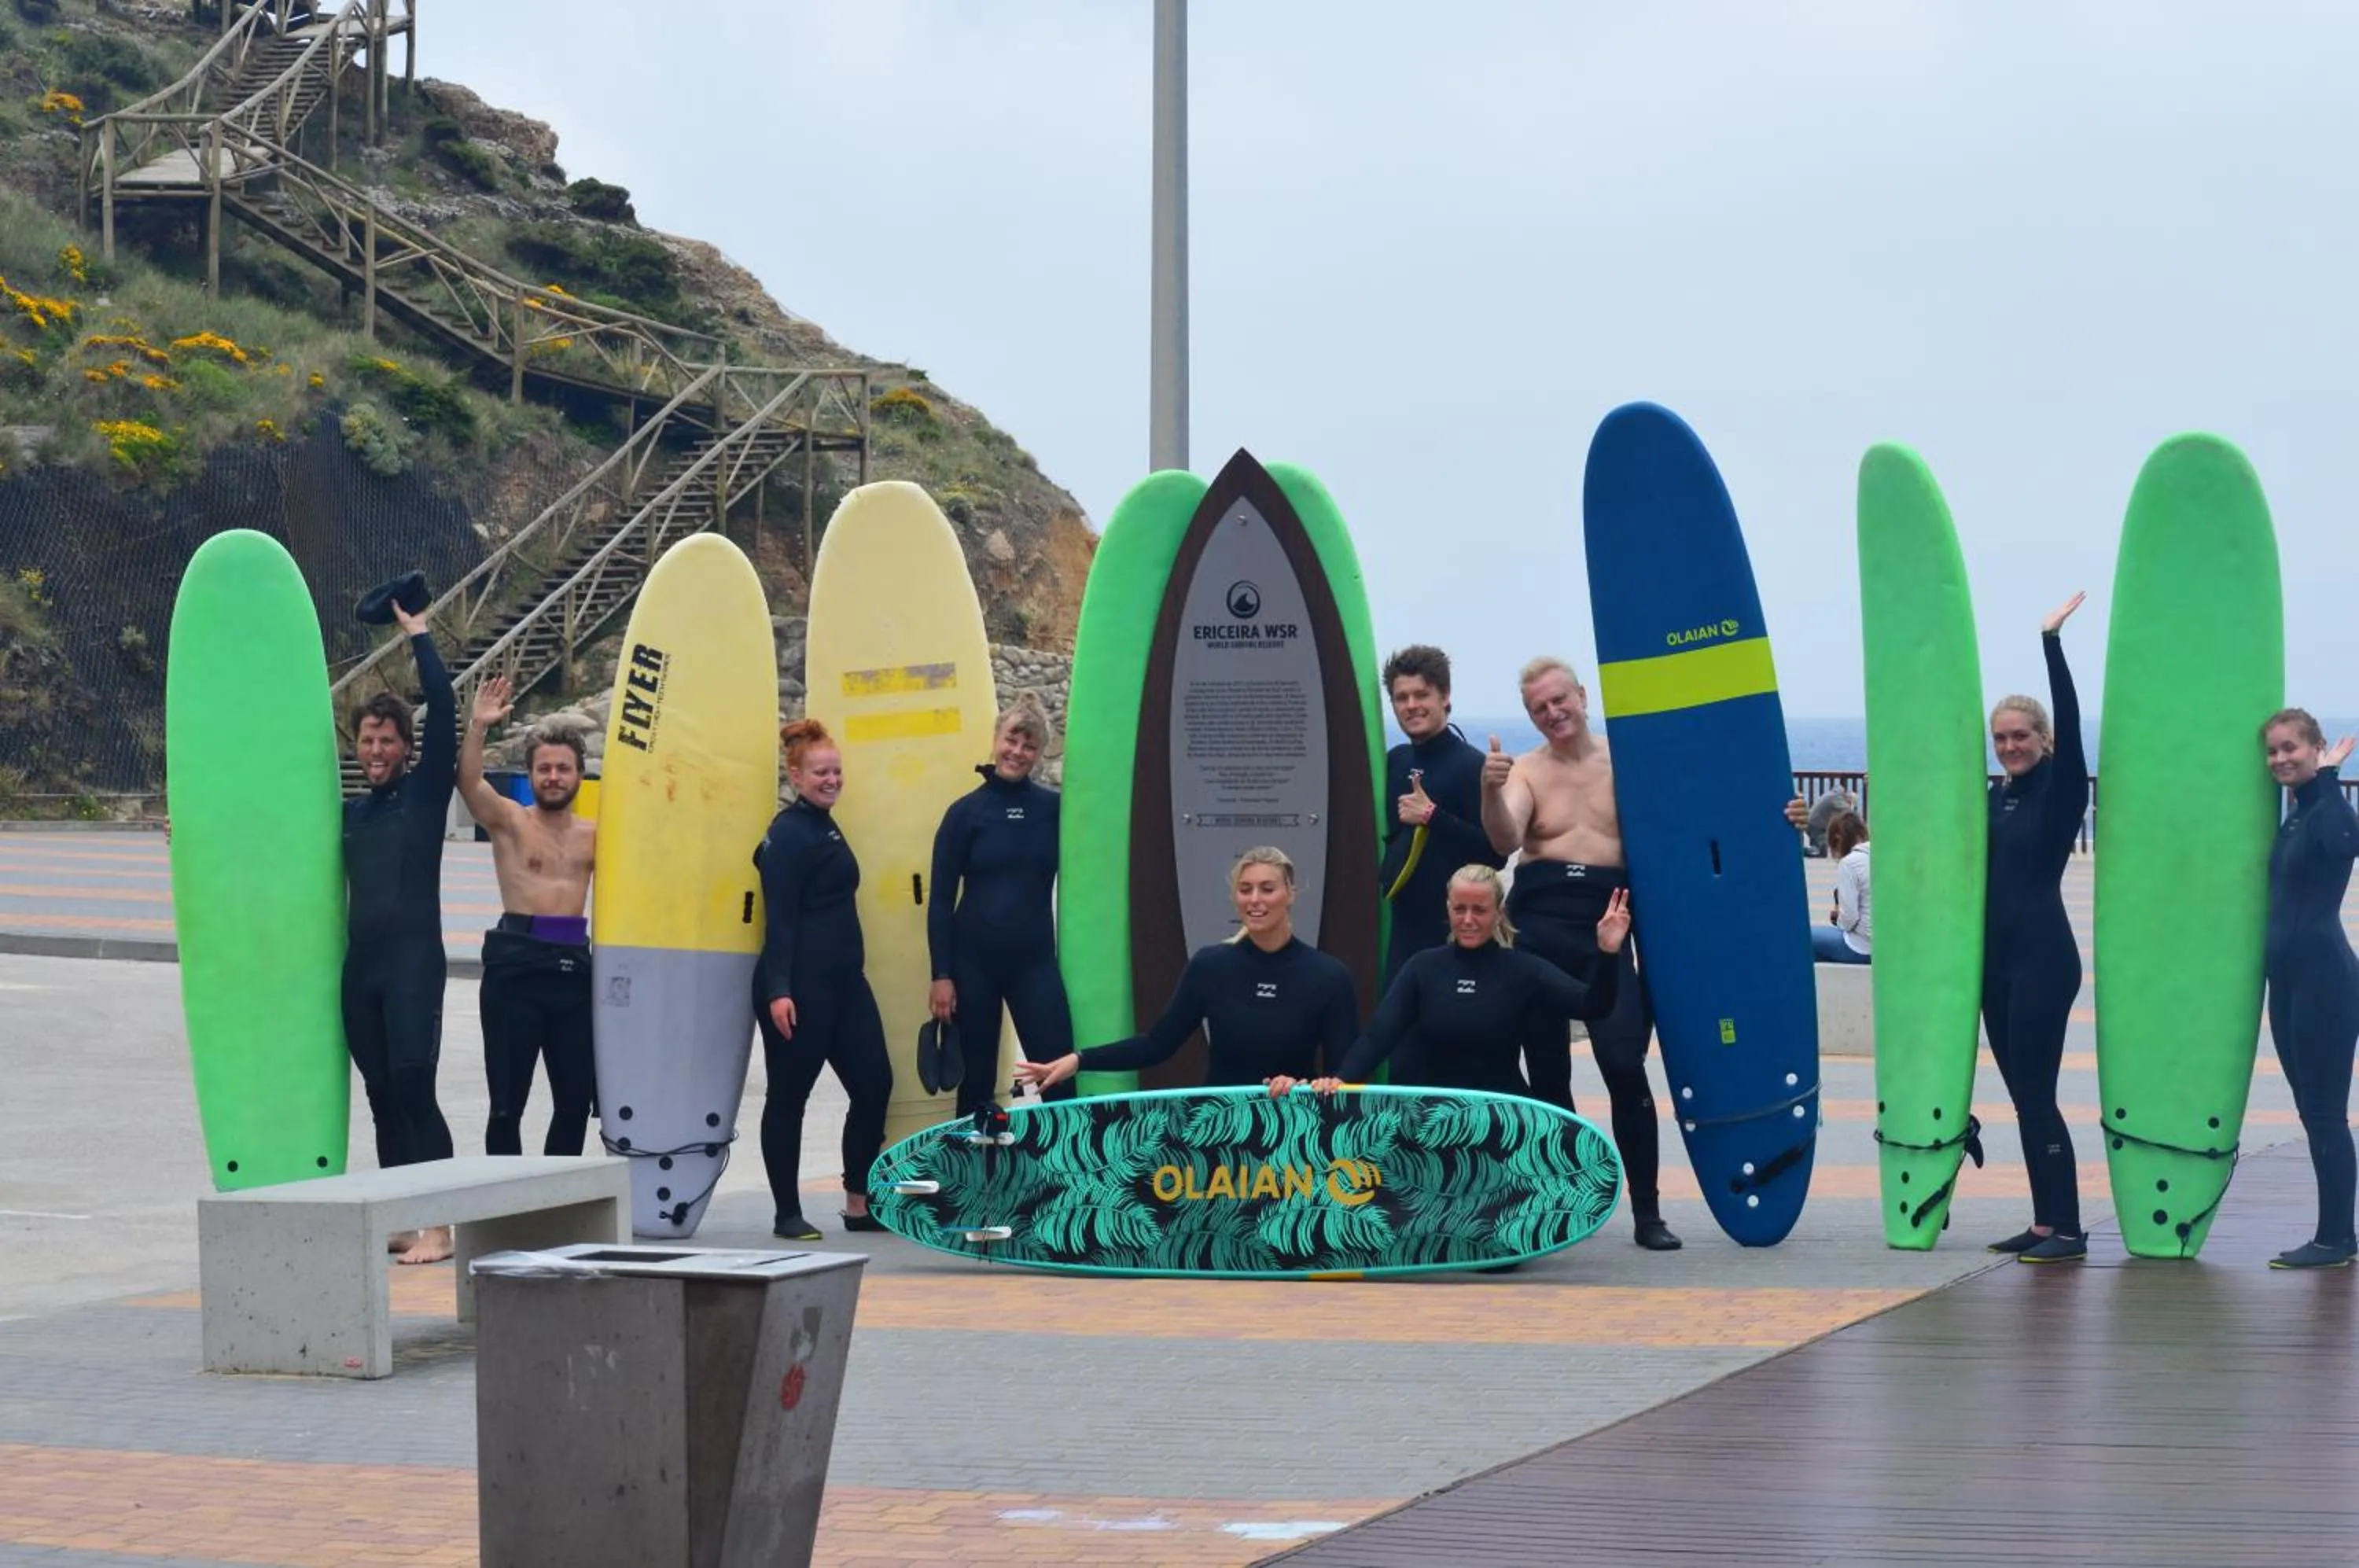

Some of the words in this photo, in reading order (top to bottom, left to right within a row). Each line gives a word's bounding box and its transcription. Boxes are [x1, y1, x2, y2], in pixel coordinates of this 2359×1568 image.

[1194, 625, 1259, 639] ERICEIRA
[1265, 624, 1297, 639] WSR
[1667, 624, 1718, 646] OLAIAN
[618, 643, 663, 751] FLYER
[1153, 1164, 1313, 1202] OLAIAN
